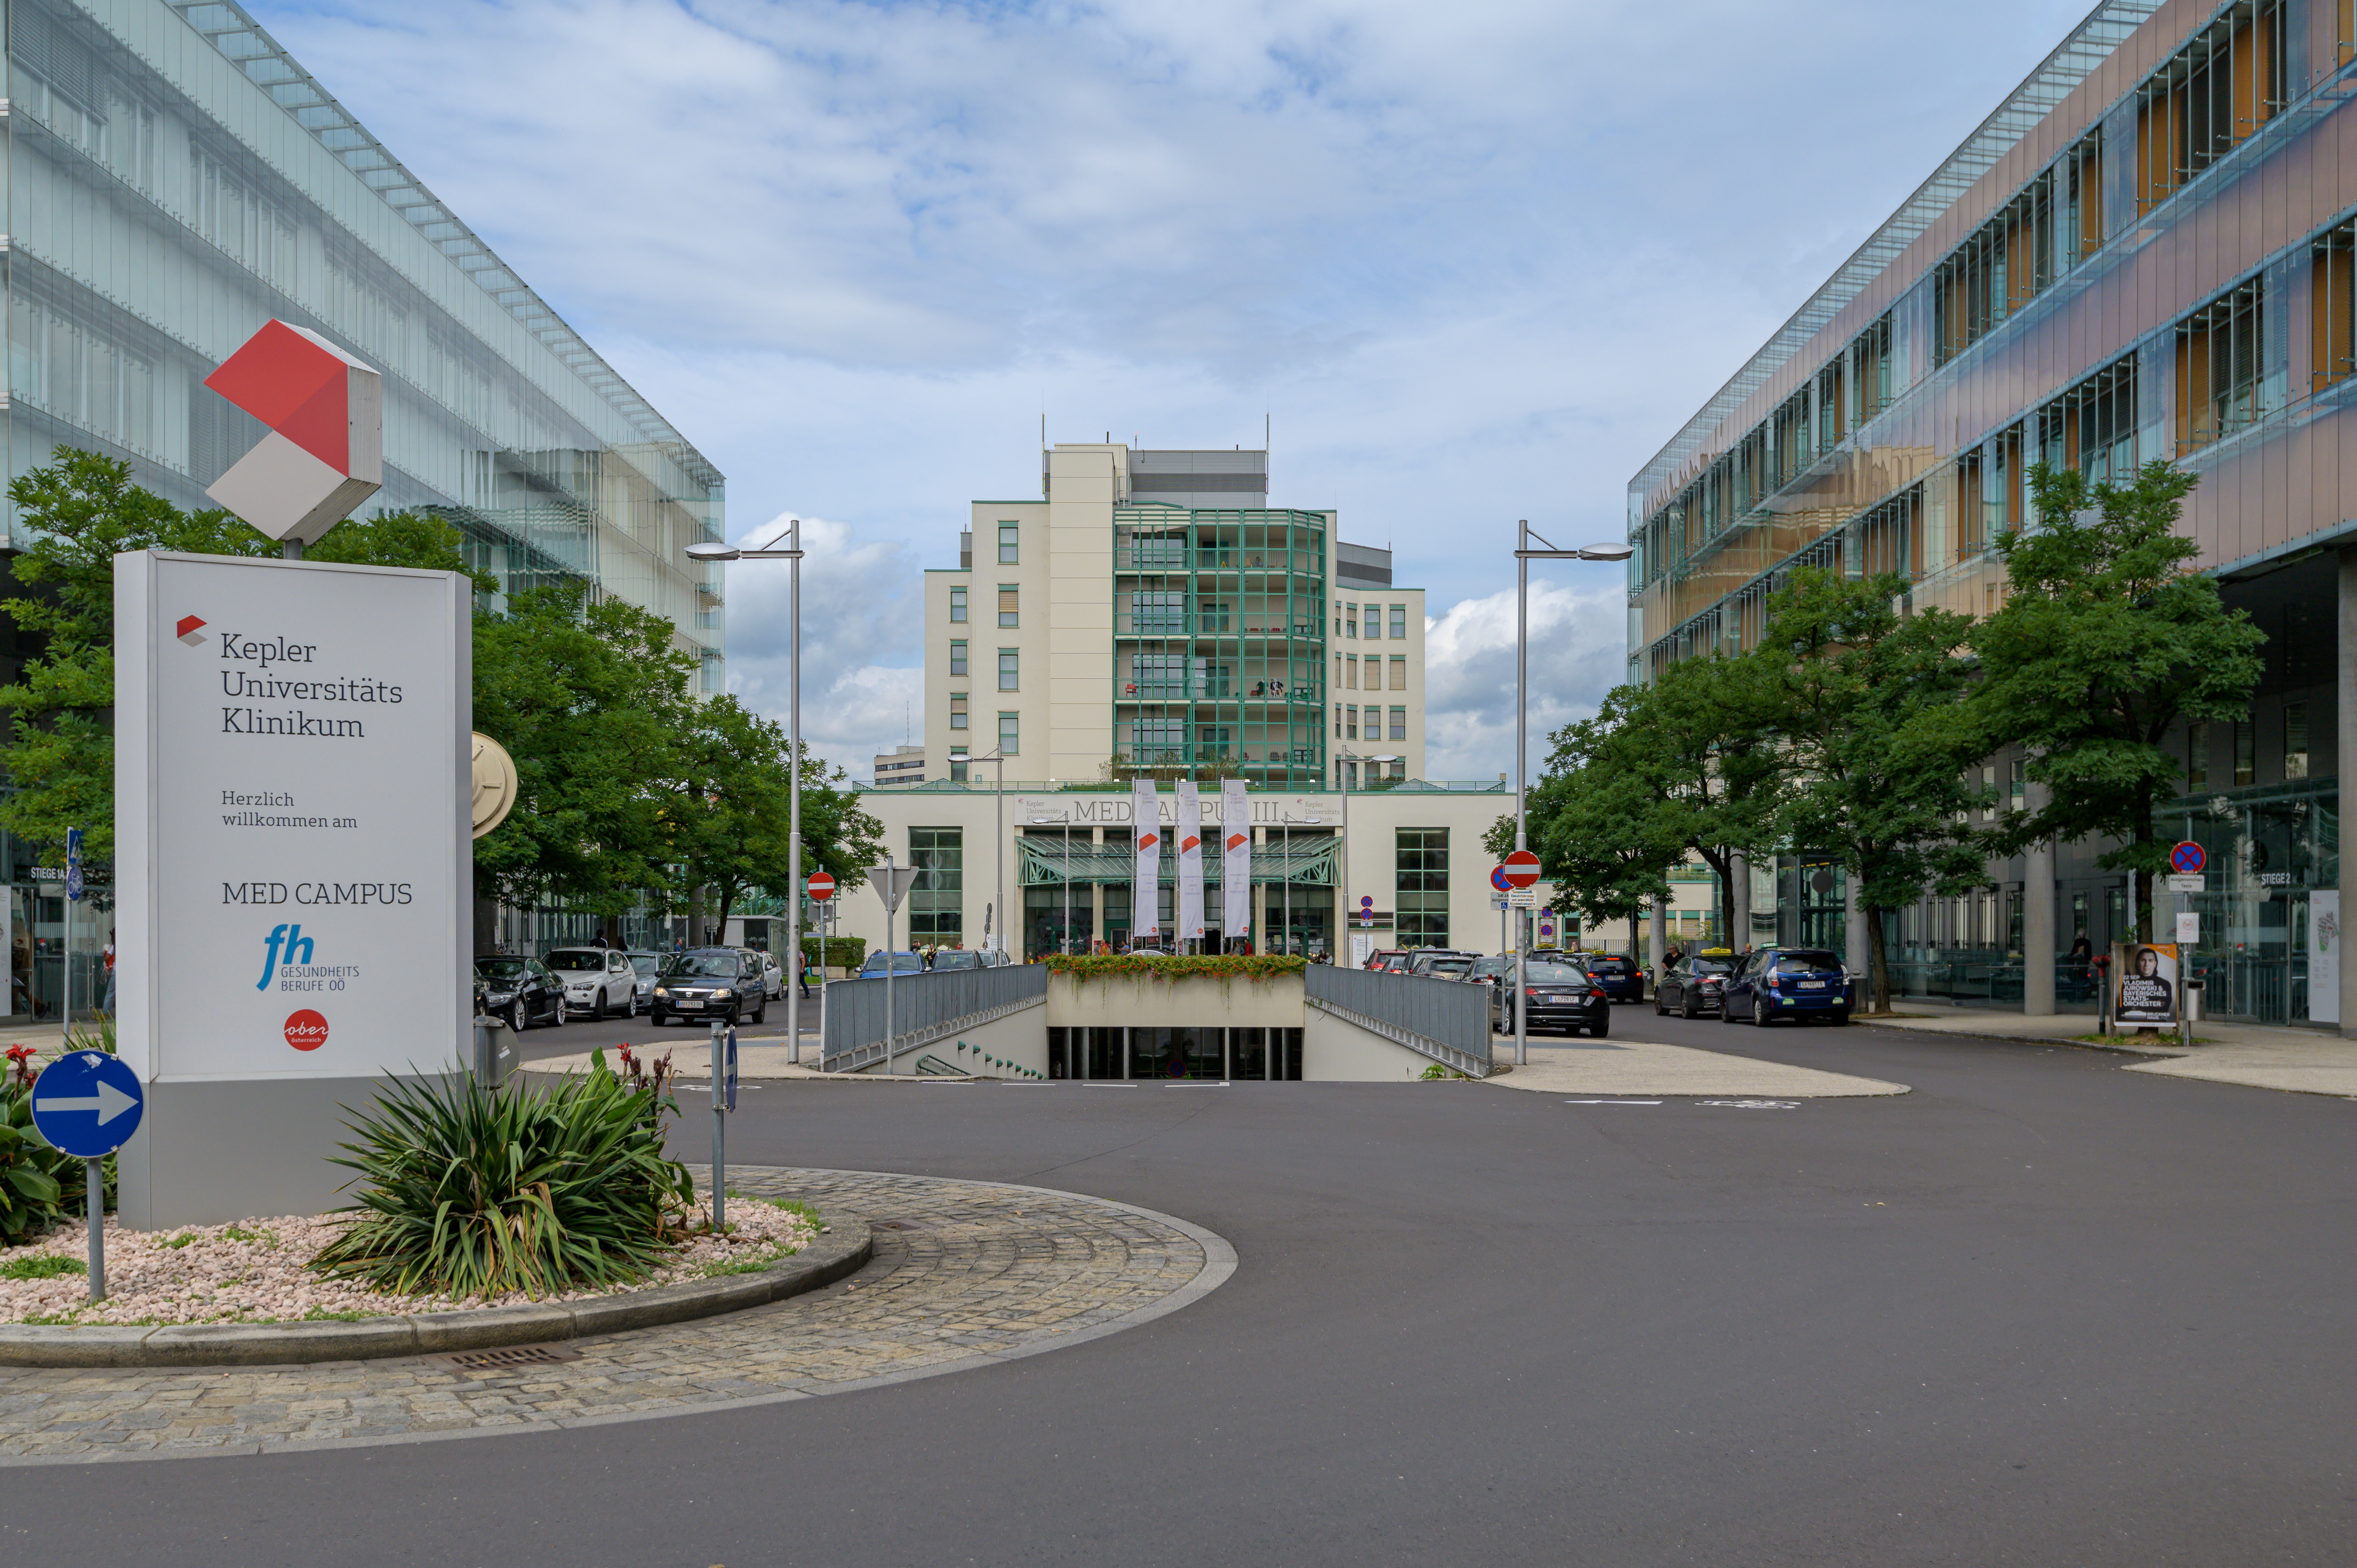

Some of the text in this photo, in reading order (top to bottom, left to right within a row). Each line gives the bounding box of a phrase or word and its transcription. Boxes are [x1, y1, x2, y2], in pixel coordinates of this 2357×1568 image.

[221, 633, 316, 667] Kepler
[221, 671, 402, 703] Universitäts
[222, 708, 364, 737] Klinikum
[222, 791, 294, 806] Herzlich
[1074, 801, 1131, 821] MED
[1253, 802, 1284, 821] III.
[222, 812, 357, 828] willkommen am
[31, 867, 65, 879] STIEGE 1A
[2262, 872, 2290, 885] STIEGE 2
[223, 883, 412, 904] MED CAMPUS
[256, 924, 314, 992] fh
[281, 966, 359, 977] GESUNDHEITS
[281, 978, 345, 991] BERUFE OÖ
[284, 1021, 329, 1035] ober
